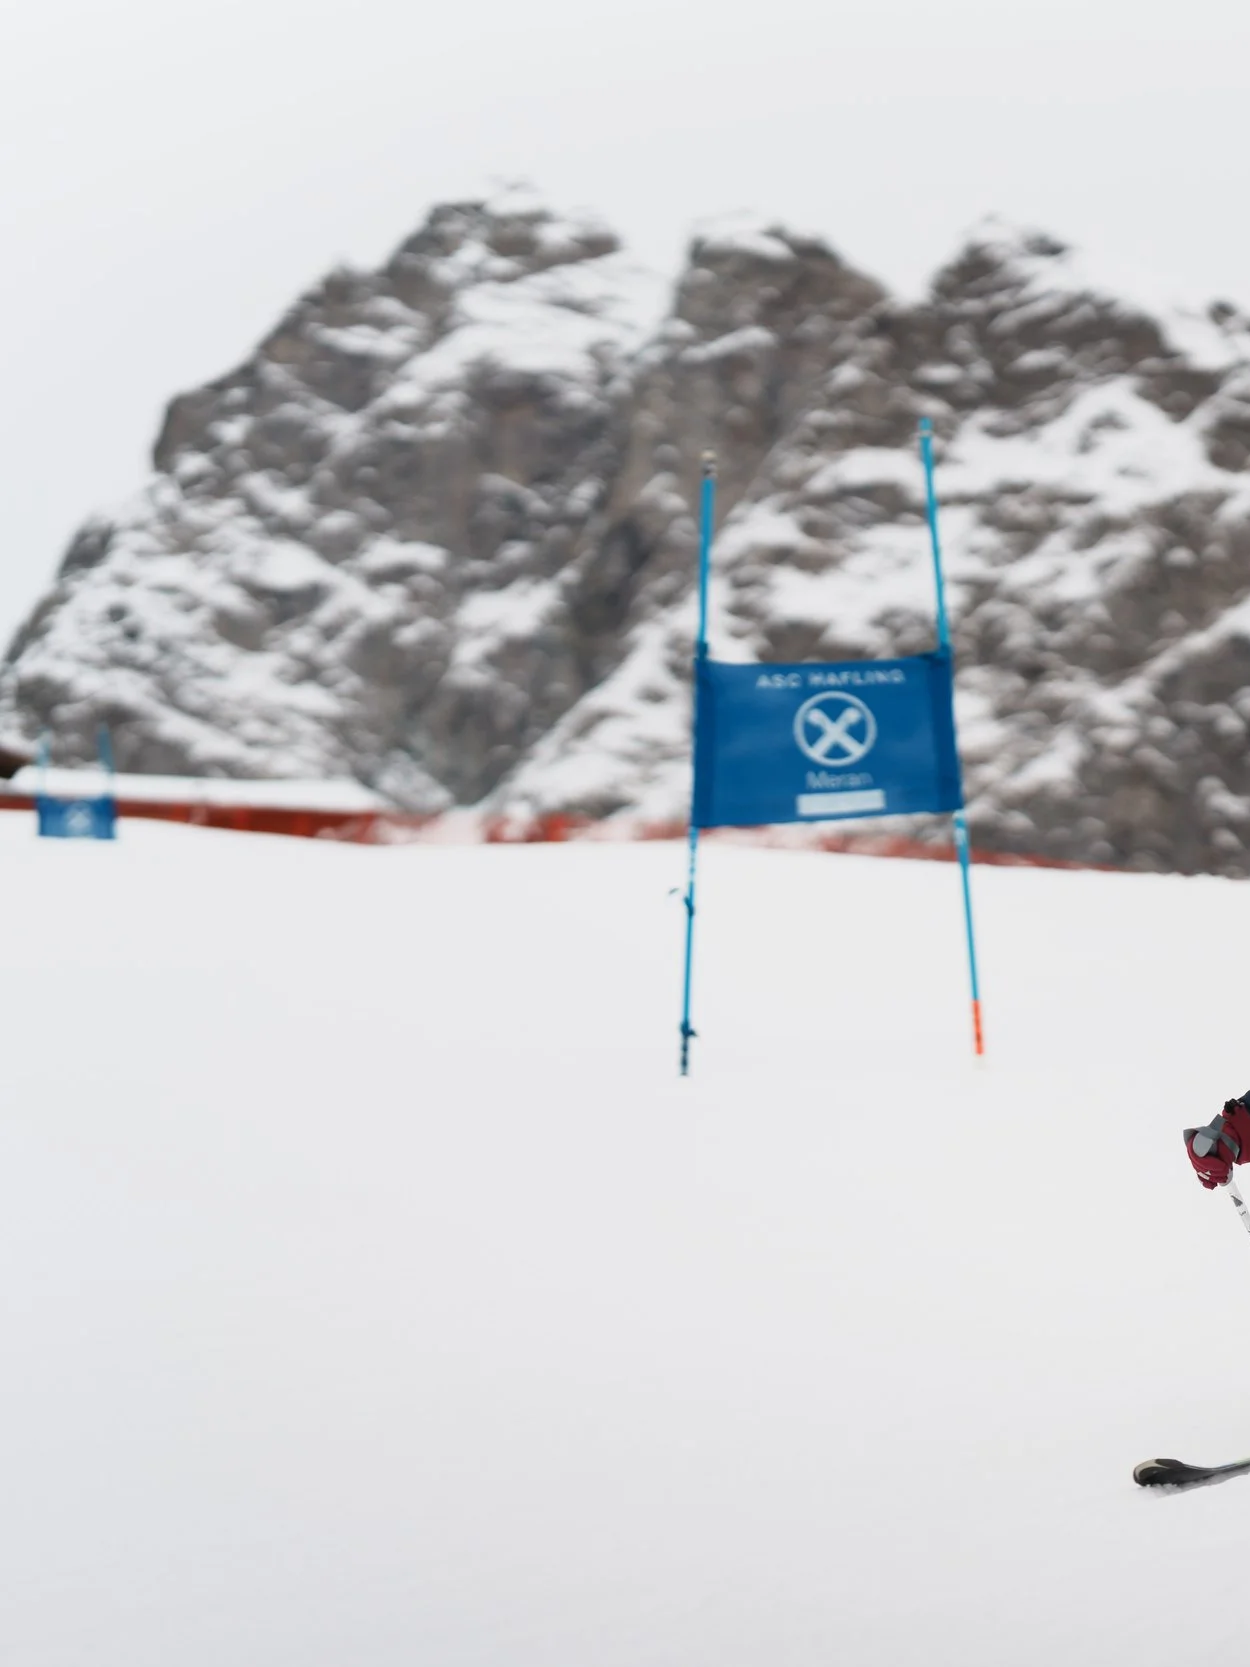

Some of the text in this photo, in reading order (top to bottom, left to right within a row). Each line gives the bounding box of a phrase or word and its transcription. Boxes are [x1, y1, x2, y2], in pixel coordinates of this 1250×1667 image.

[755, 669, 906, 688] ASC HAFLING
[805, 770, 874, 789] Meran
